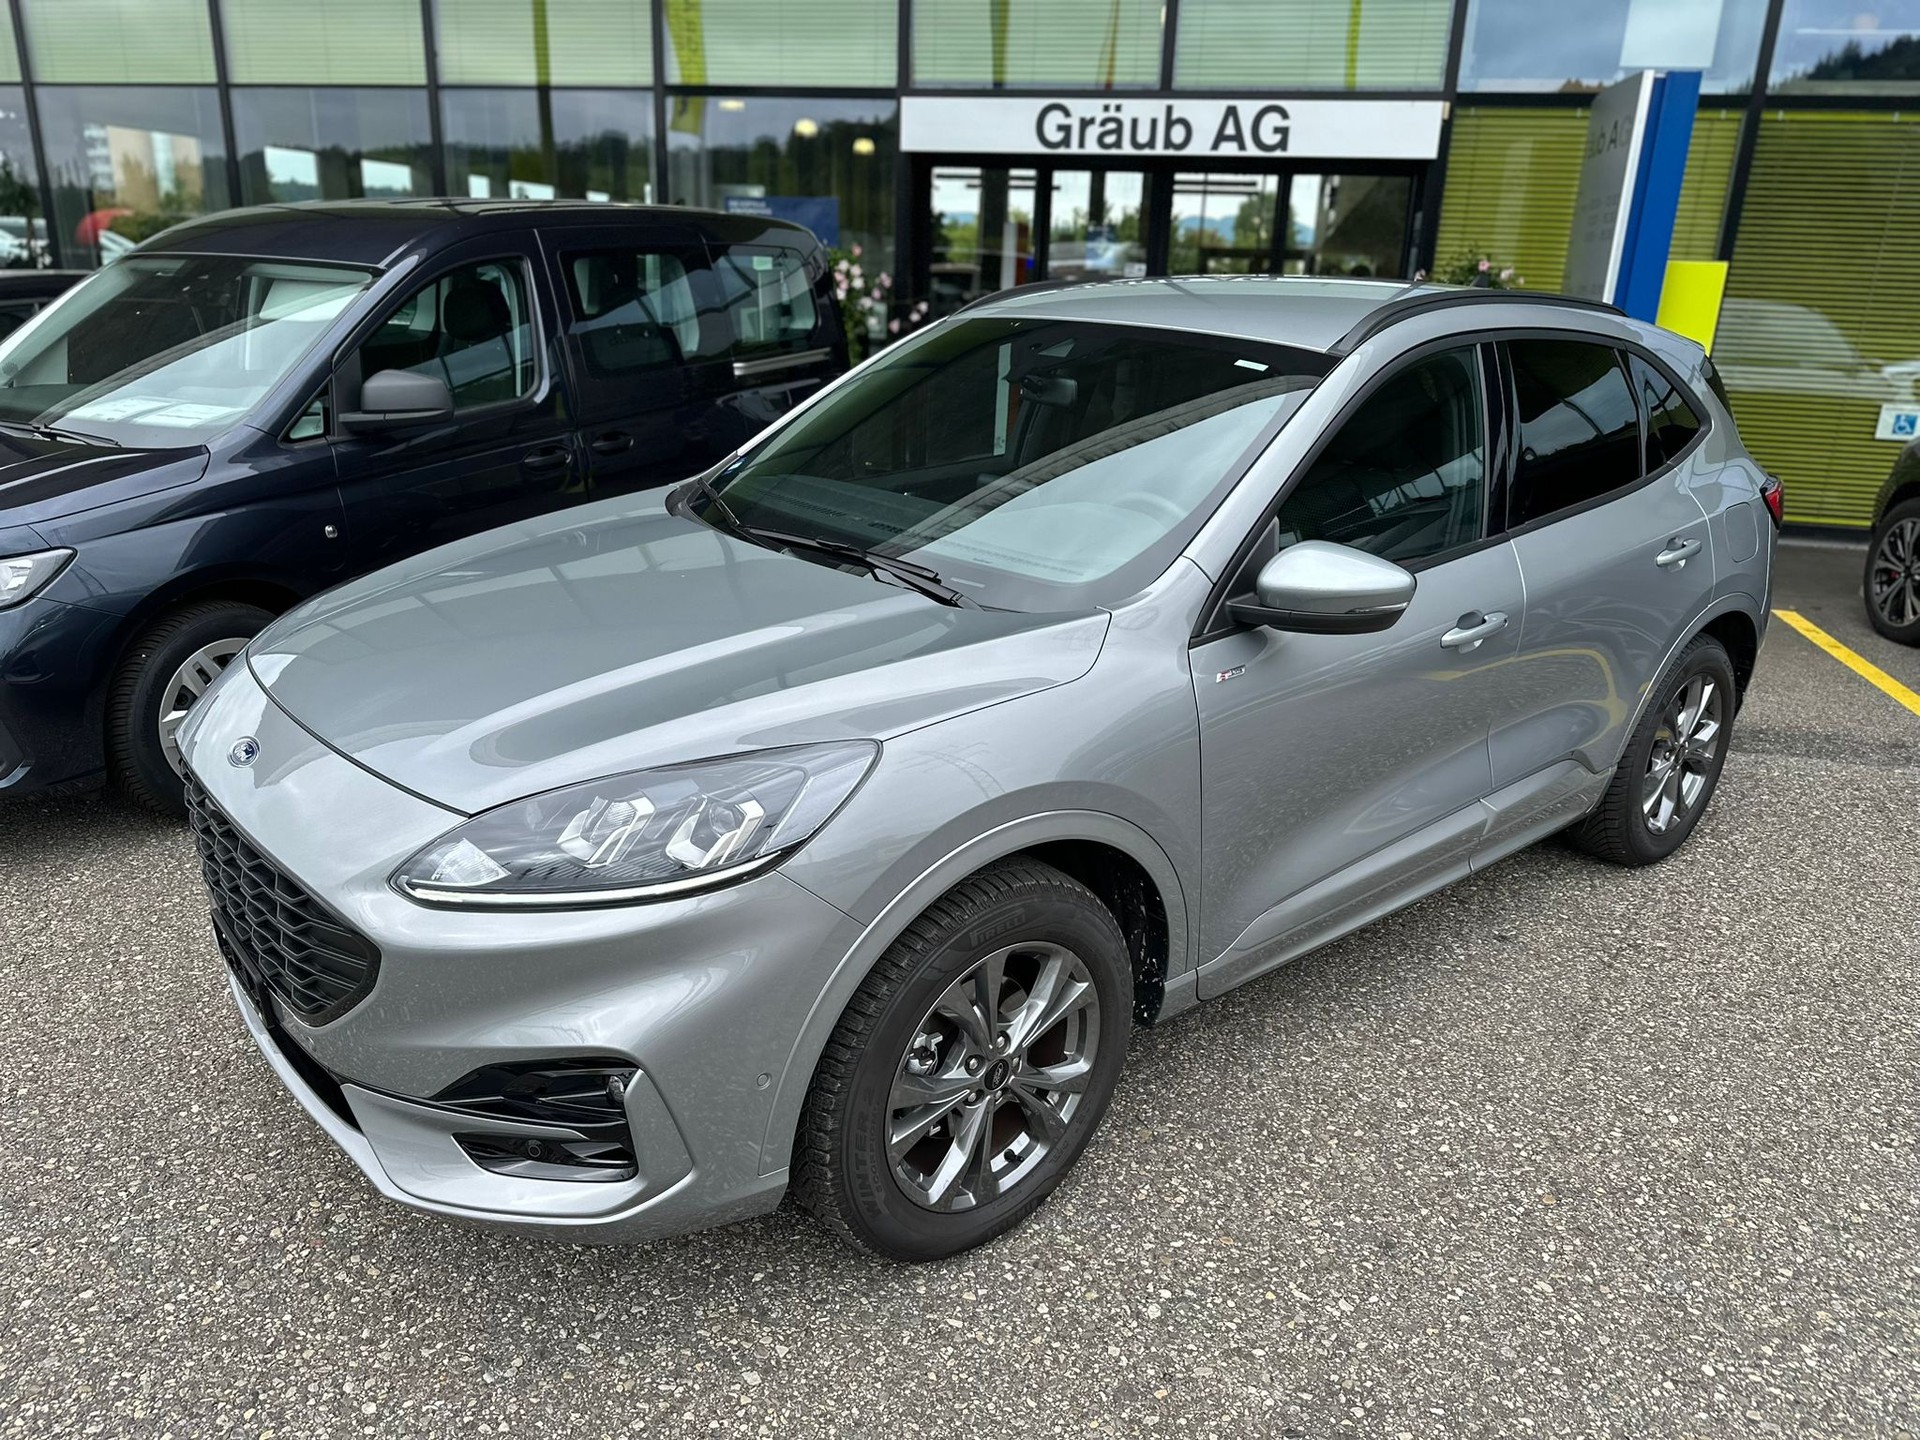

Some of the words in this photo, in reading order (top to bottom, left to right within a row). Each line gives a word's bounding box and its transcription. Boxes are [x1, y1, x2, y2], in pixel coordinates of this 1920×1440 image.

[1035, 101, 1194, 152] Gräub
[1209, 103, 1291, 154] AG
[854, 1110, 882, 1219] WINTER
